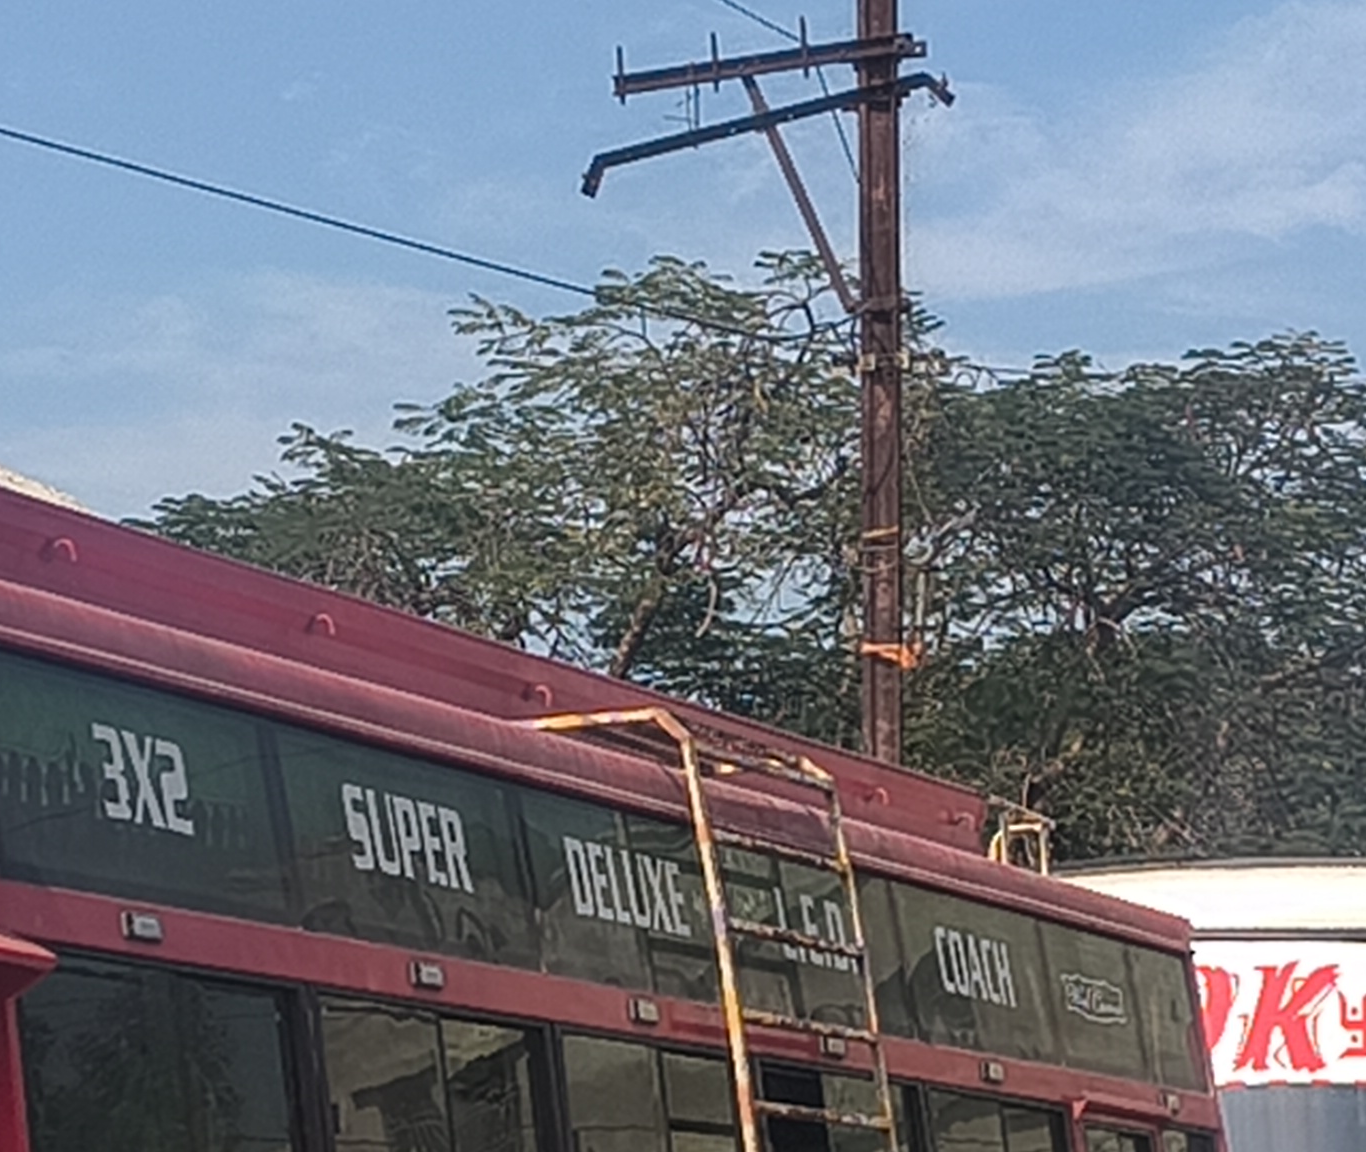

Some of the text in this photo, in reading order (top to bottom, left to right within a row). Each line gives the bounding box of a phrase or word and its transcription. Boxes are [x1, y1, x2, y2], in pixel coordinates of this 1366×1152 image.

[92, 722, 195, 836] 3X2
[341, 783, 475, 893] SUPER
[563, 836, 691, 937] DELUXE
[935, 926, 1017, 1008] COACH
